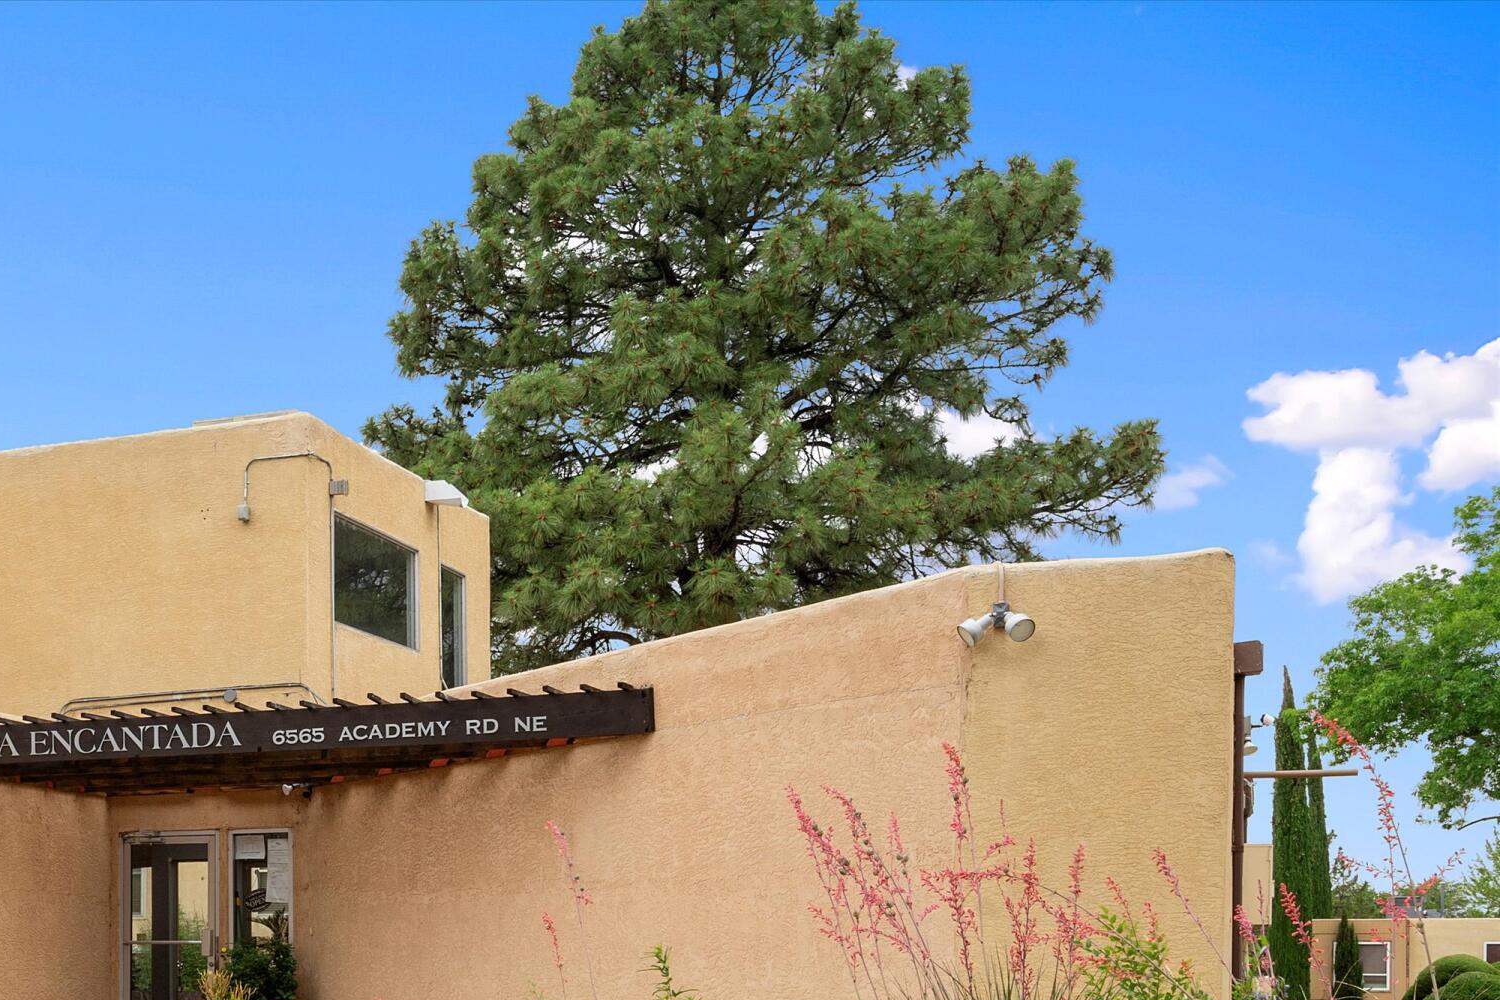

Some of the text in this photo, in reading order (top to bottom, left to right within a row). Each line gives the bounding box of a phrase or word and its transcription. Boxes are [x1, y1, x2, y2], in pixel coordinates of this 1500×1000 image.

[29, 720, 243, 757] ENCANTADA
[271, 715, 548, 745] 6565 ACADEMY RD NE
